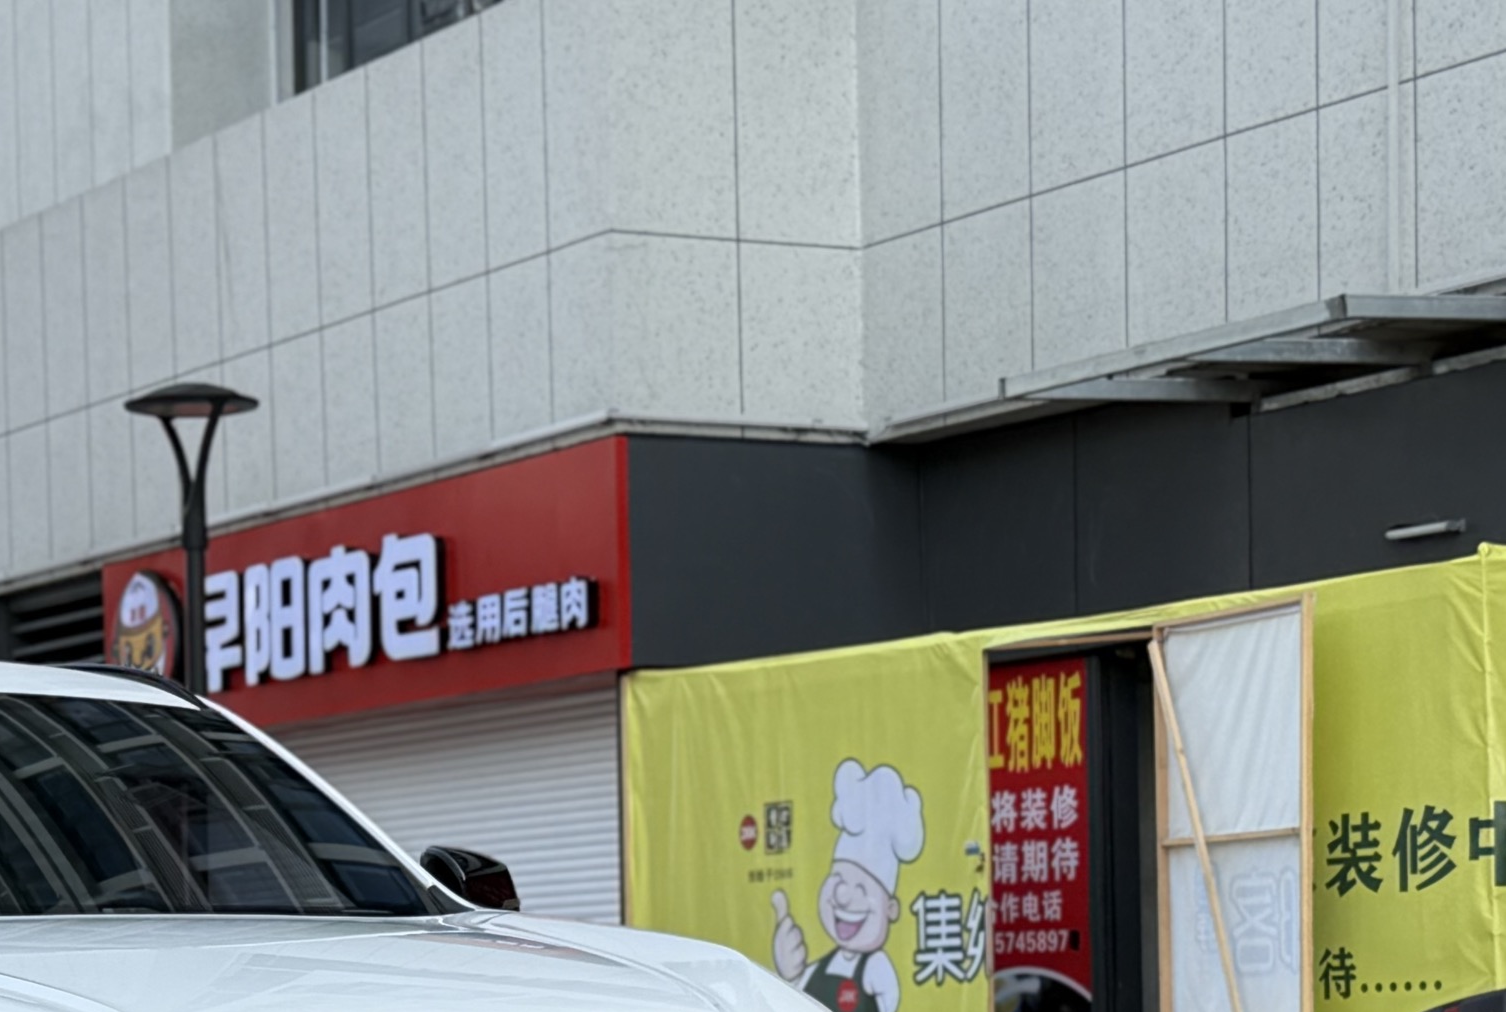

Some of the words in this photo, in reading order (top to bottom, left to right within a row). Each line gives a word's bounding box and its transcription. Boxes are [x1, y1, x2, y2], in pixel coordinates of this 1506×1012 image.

[447, 576, 588, 650] 选用后腿肉
[991, 785, 1079, 833] 将装修
[992, 837, 1080, 884] 请期待
[1313, 804, 1506, 898] 装修中
[994, 929, 1081, 954] 5745897
